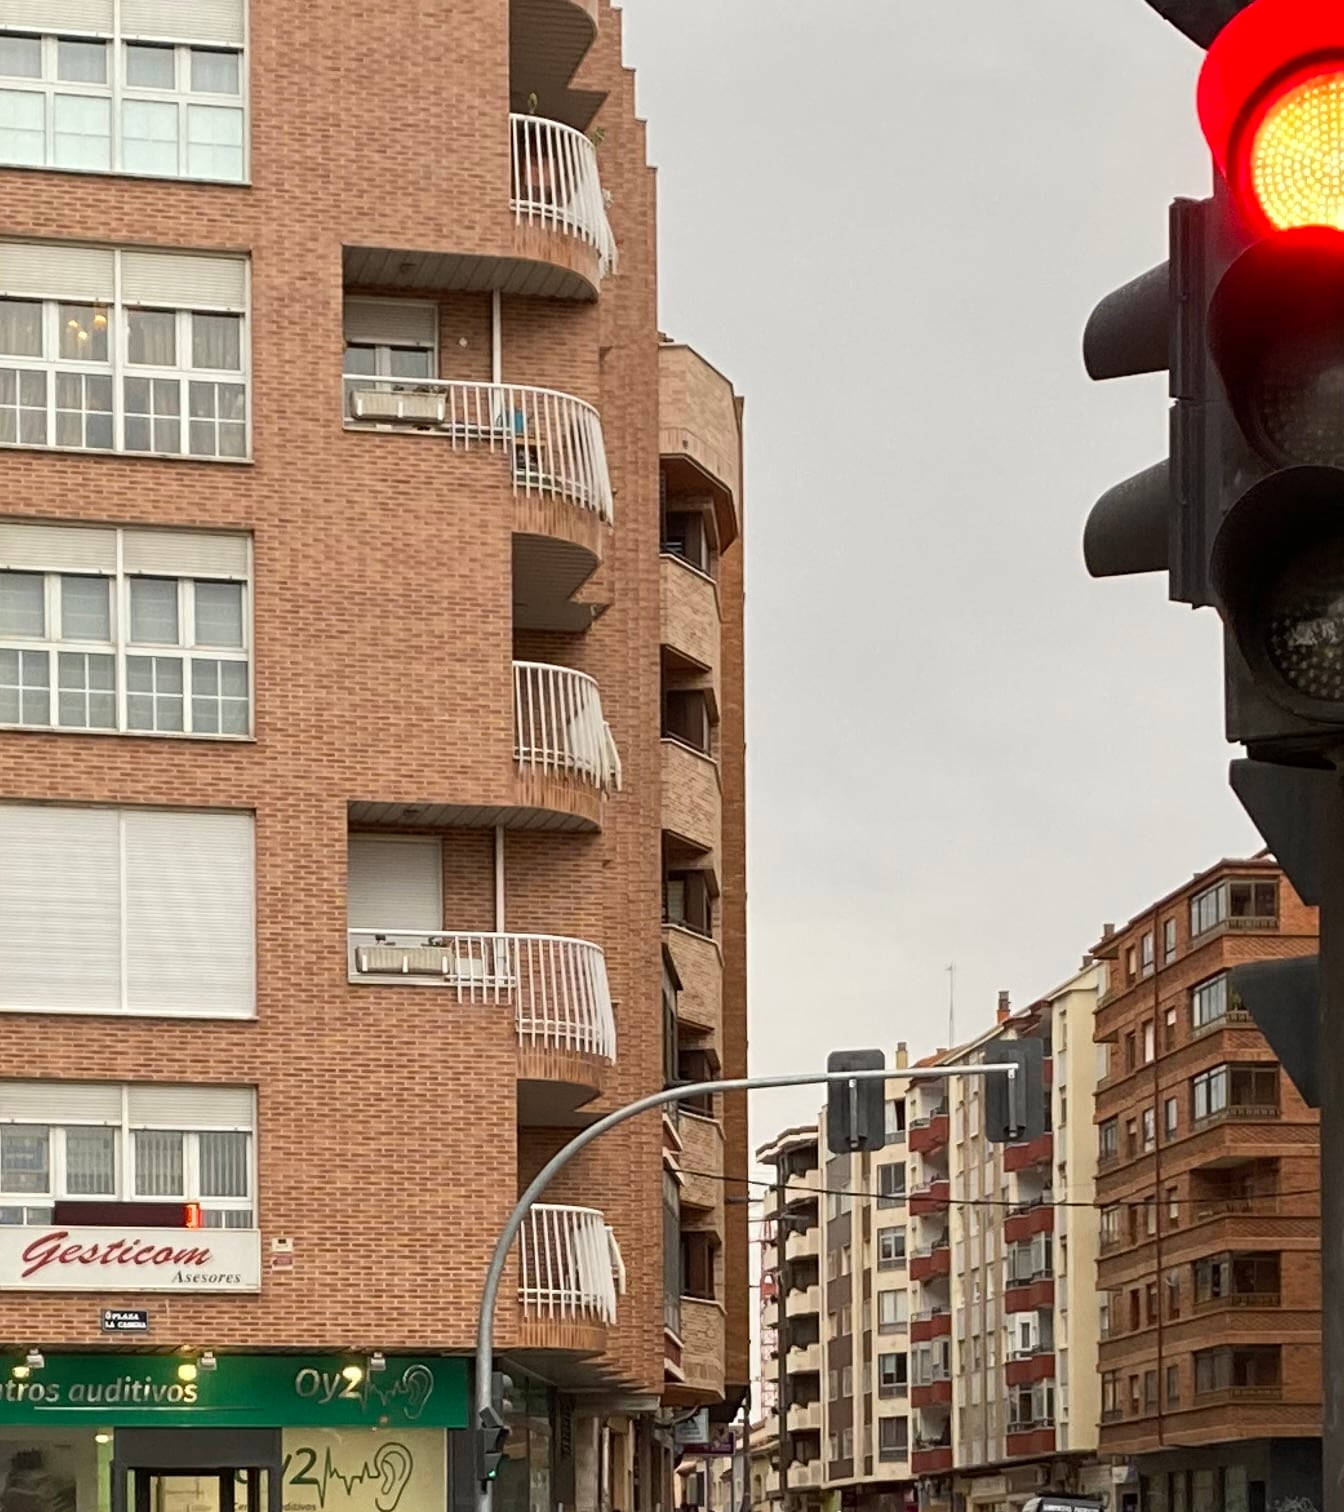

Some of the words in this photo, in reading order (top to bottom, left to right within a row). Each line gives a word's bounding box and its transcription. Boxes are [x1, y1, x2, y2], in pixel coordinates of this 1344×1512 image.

[21, 1231, 211, 1278] Gesticom
[172, 1270, 242, 1284] Asesores
[112, 1313, 140, 1321] PLAZA
[68, 1376, 198, 1403] auditivos
[294, 1367, 362, 1403] Oy2
